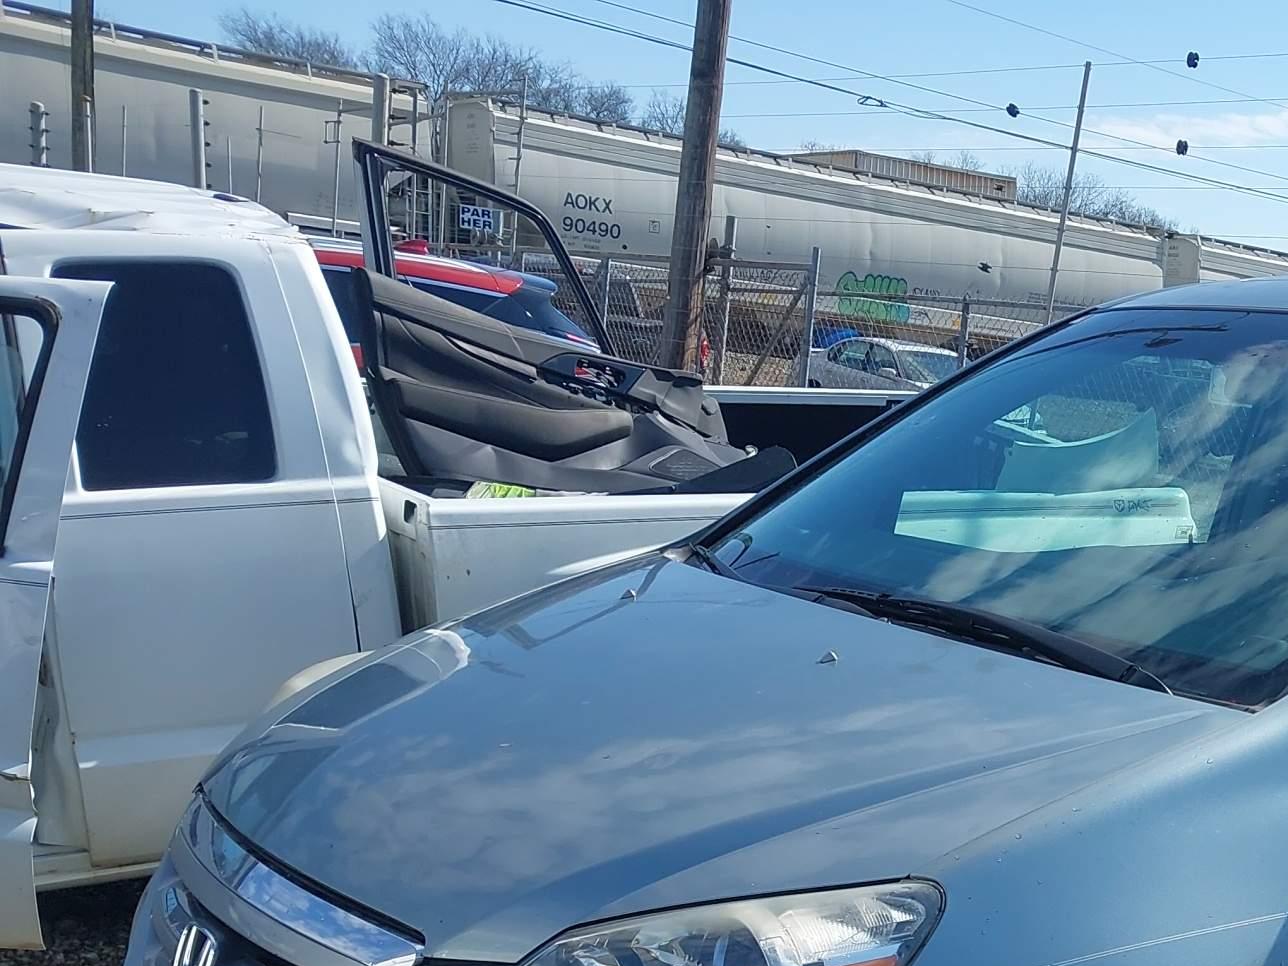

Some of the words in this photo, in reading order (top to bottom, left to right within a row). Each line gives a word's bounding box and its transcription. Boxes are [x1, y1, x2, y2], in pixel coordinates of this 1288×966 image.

[563, 192, 612, 214] AOKX
[462, 206, 492, 219] PAR
[462, 217, 492, 230] HER
[562, 216, 621, 239] 90490
